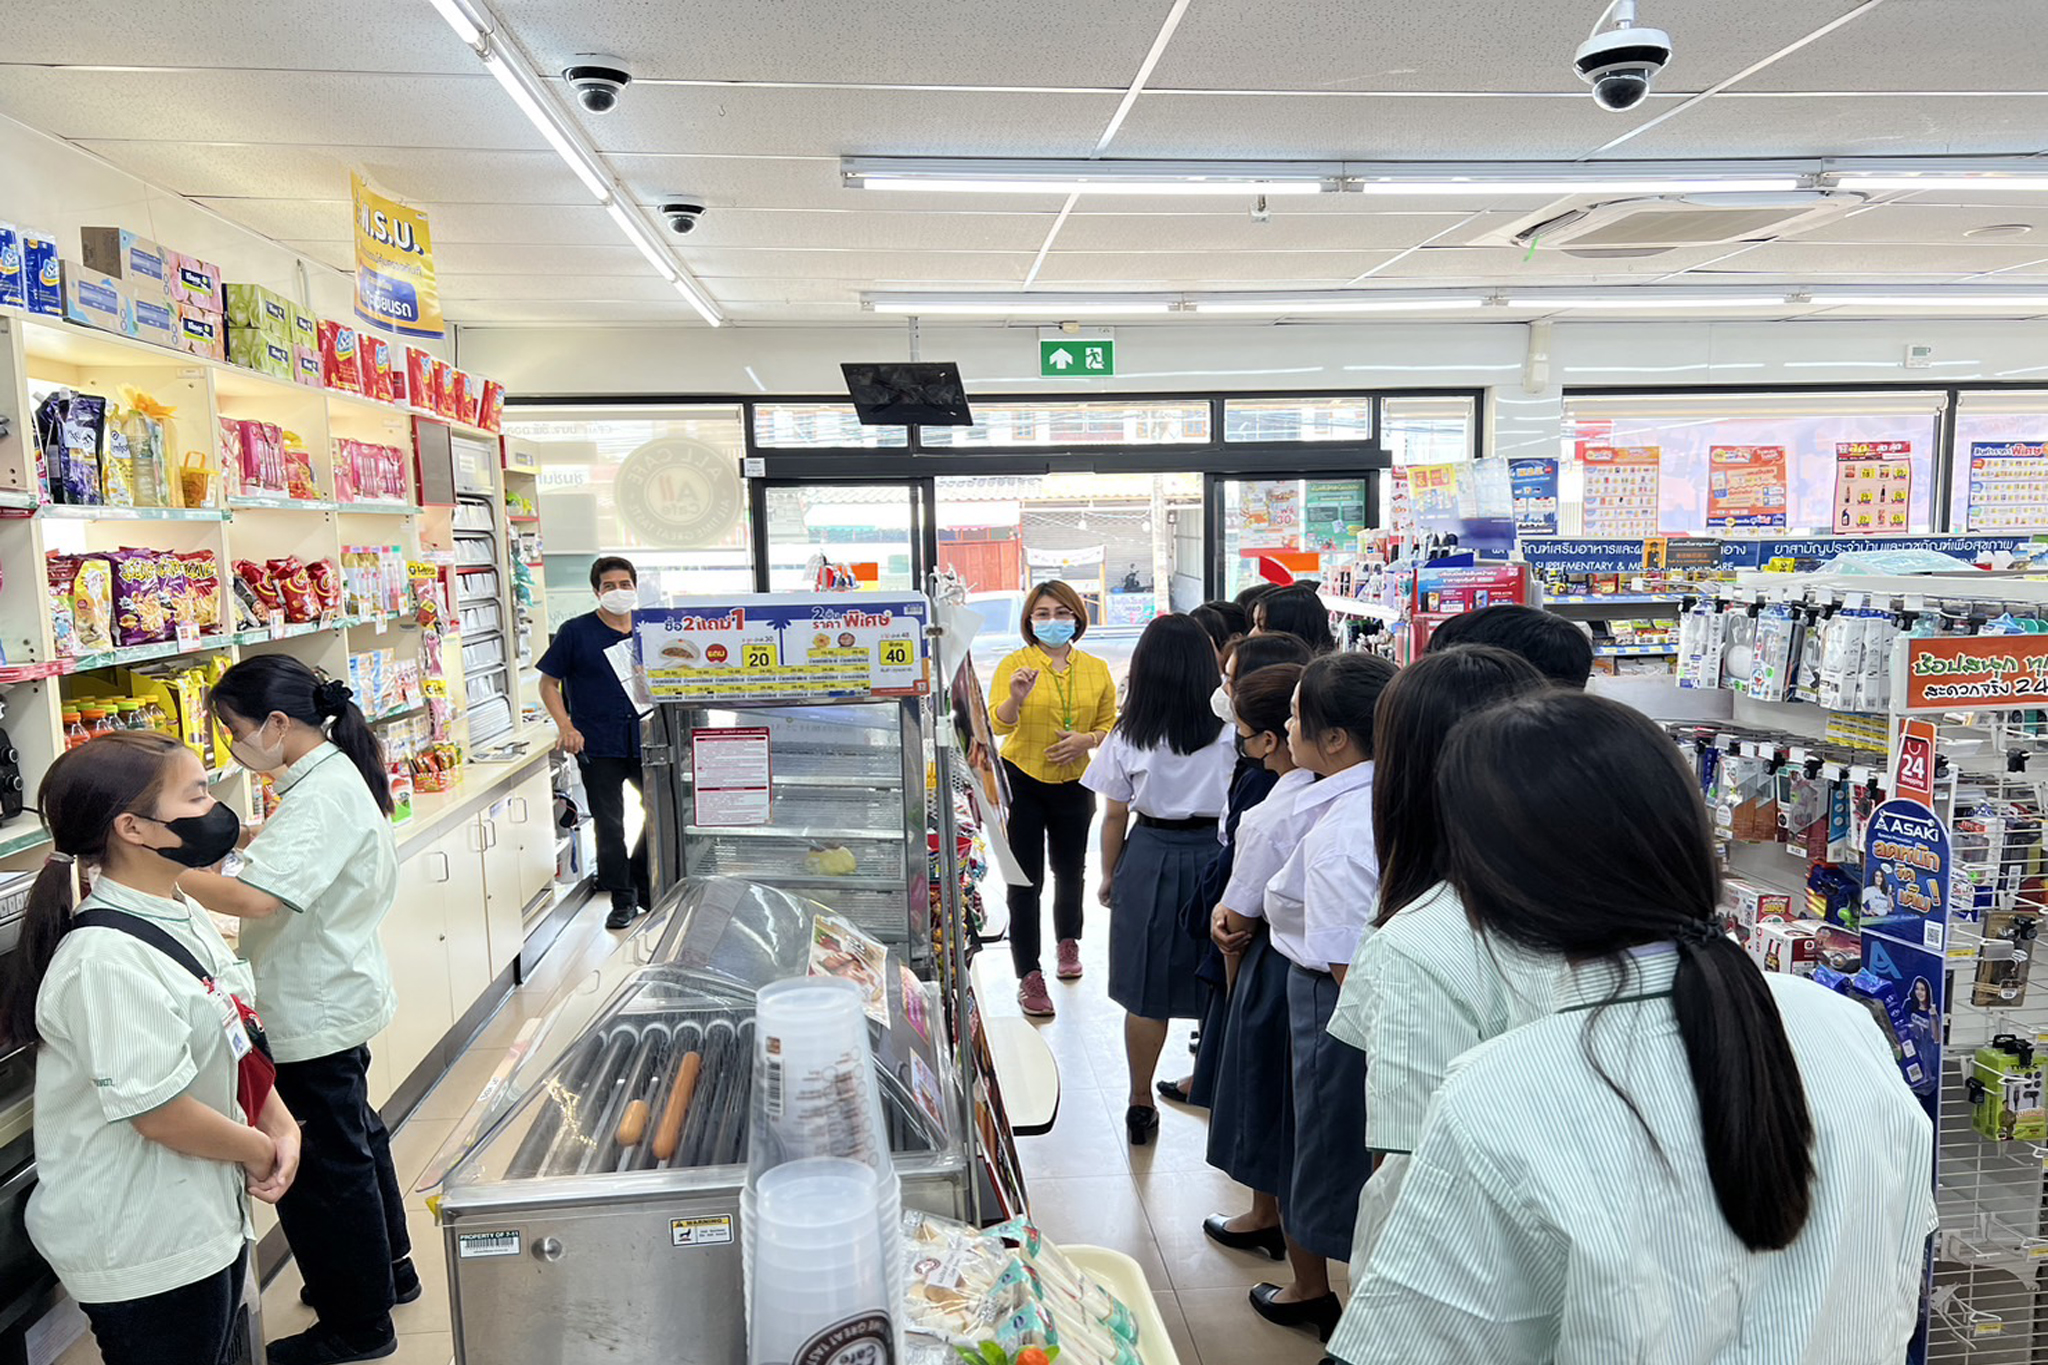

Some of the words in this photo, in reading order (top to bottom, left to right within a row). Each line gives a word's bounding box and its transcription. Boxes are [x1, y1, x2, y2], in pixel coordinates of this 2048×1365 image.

[1535, 561, 1614, 571] SUPPLEMENTARY
[1617, 561, 1625, 571] &
[812, 620, 841, 630] ราคา
[749, 653, 769, 667] 20
[886, 648, 906, 663] 40
[1912, 652, 2018, 679] ช้อปสนุก
[1923, 679, 2010, 699] สะดวกจริง
[1901, 754, 1925, 779] 24
[686, 1218, 723, 1226] WARNING
[459, 1233, 494, 1241] PROPERTY
[829, 1321, 867, 1346] GREAT
